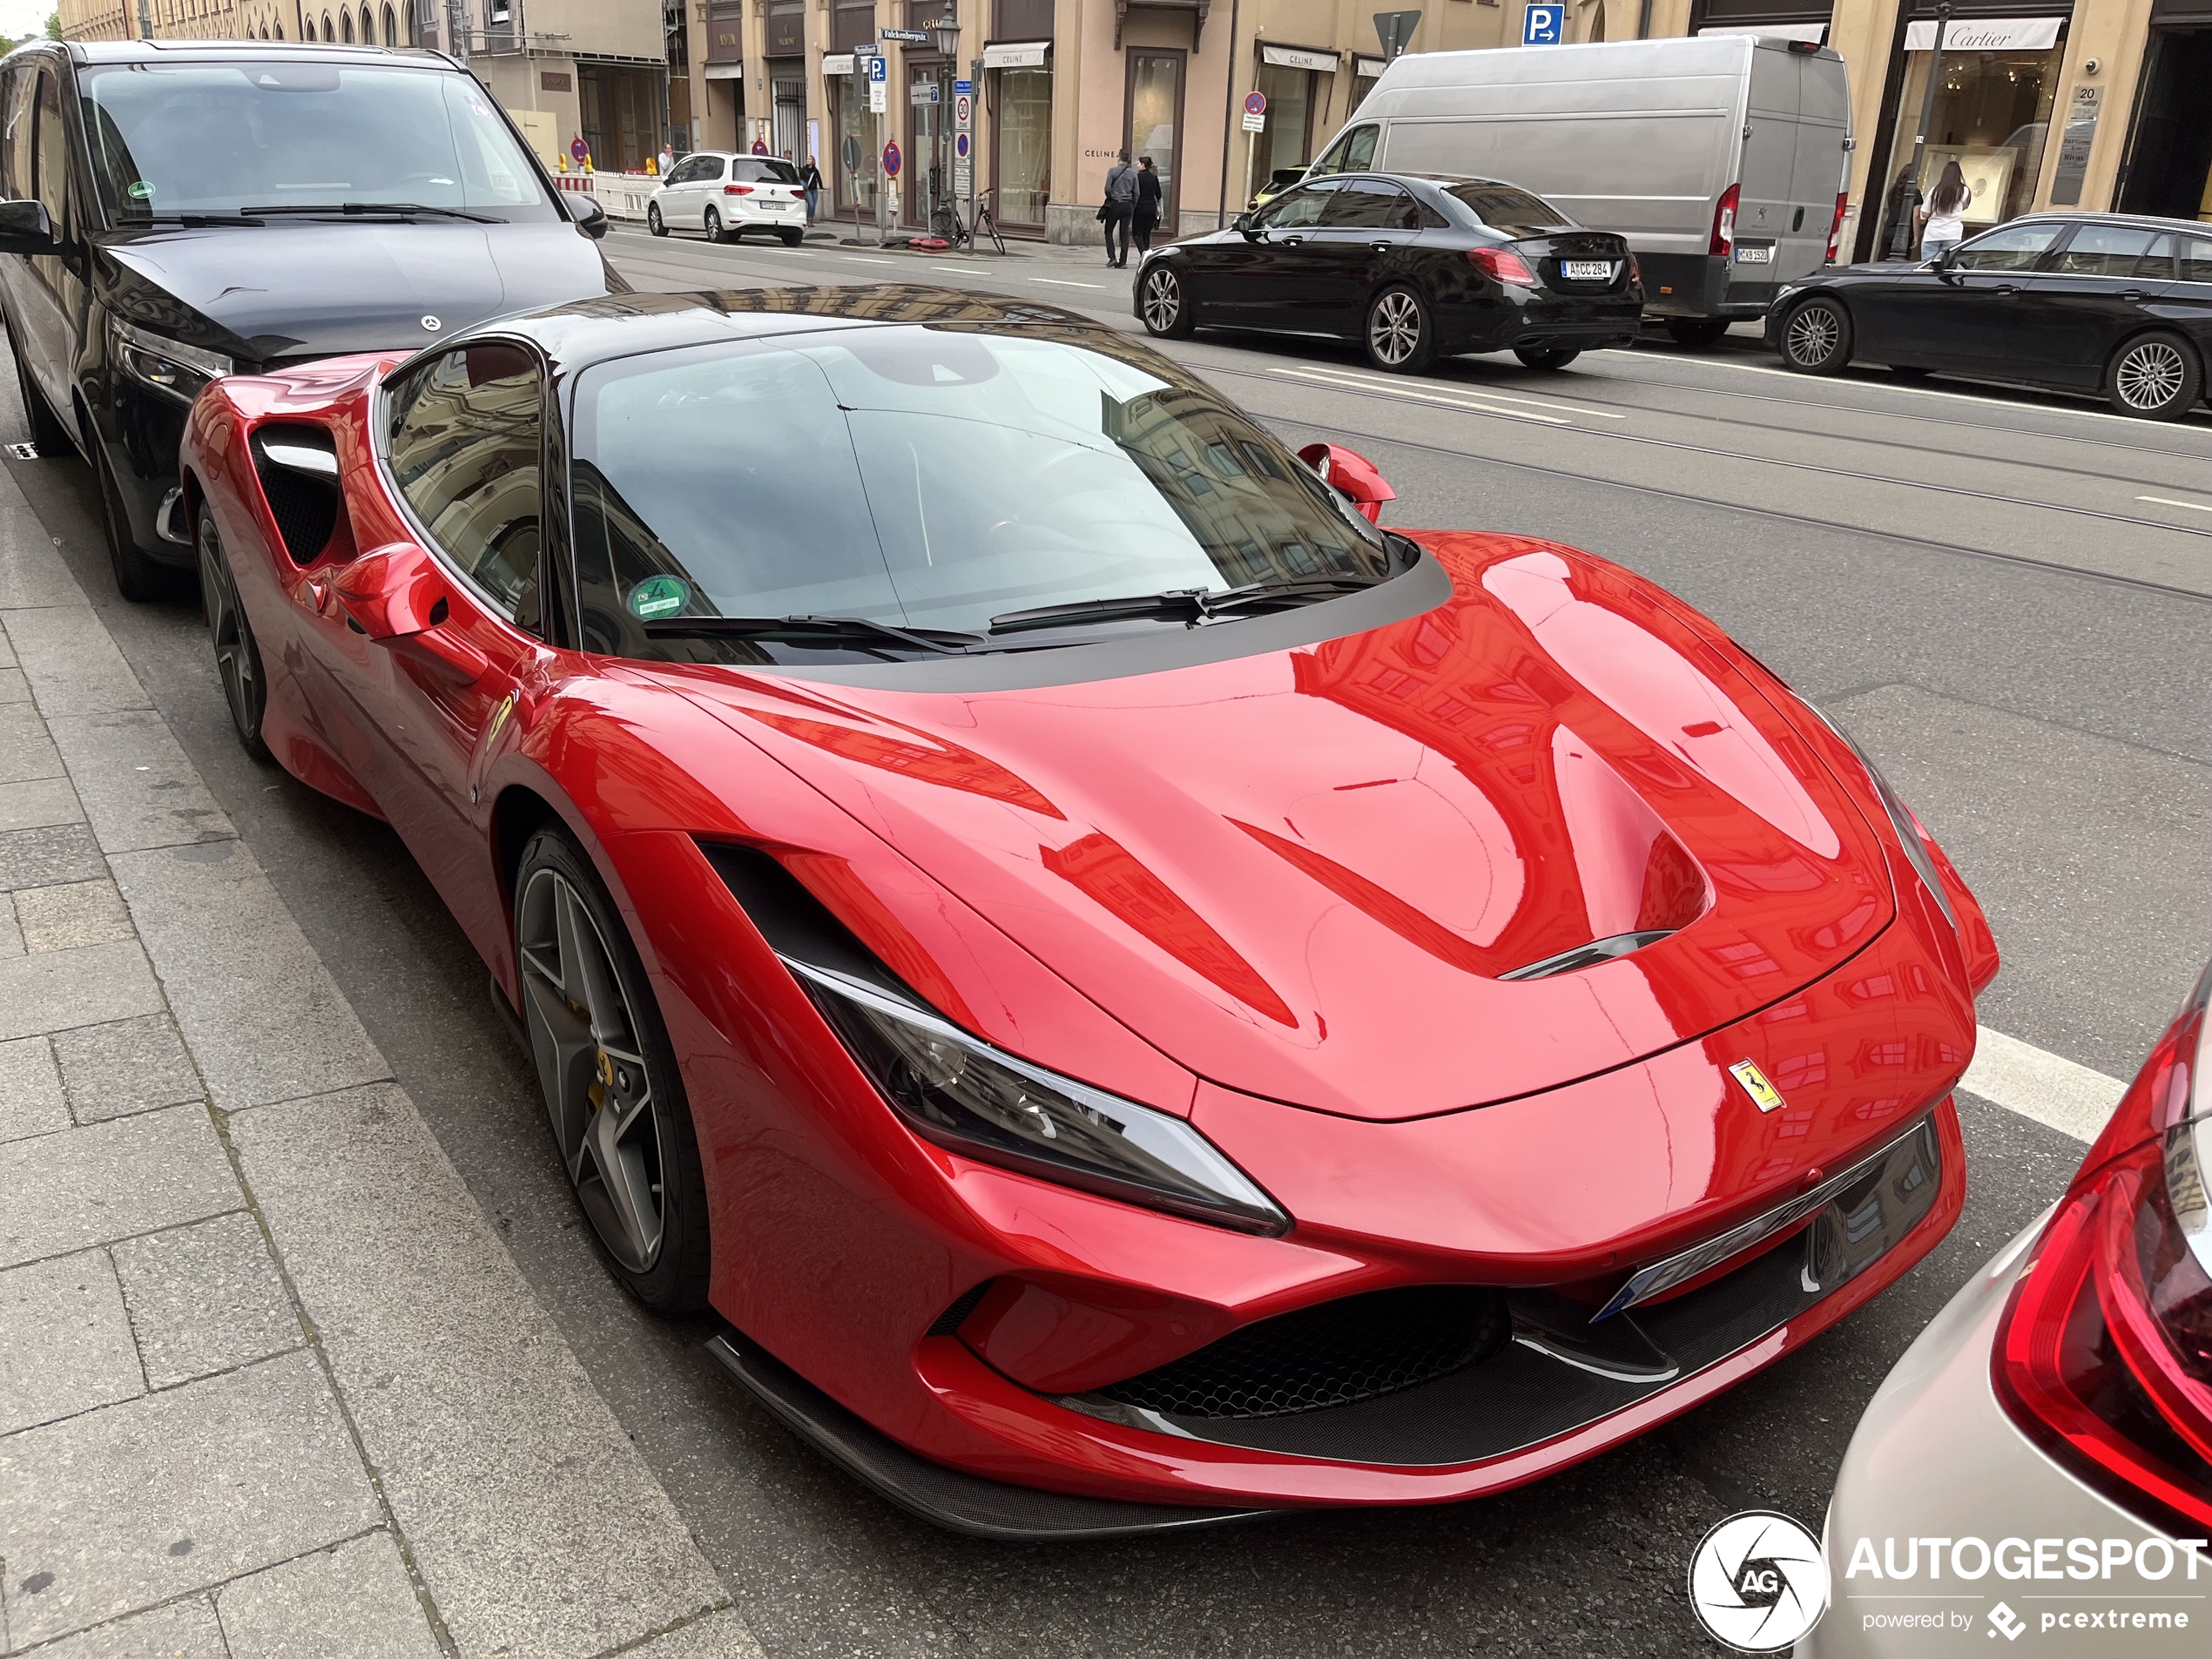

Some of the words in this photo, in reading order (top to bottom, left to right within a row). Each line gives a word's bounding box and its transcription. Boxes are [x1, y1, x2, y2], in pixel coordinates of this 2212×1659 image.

[1529, 10, 1551, 41] P
[1950, 26, 2011, 46] Cartier
[1002, 55, 1022, 64] CELINE
[1289, 55, 1313, 65] CELINE
[872, 60, 882, 79] P
[2080, 88, 2094, 98] 20
[1571, 263, 1575, 275] A
[1581, 264, 1591, 275] CC
[1593, 264, 1607, 275] 284
[651, 582, 666, 598] 4
